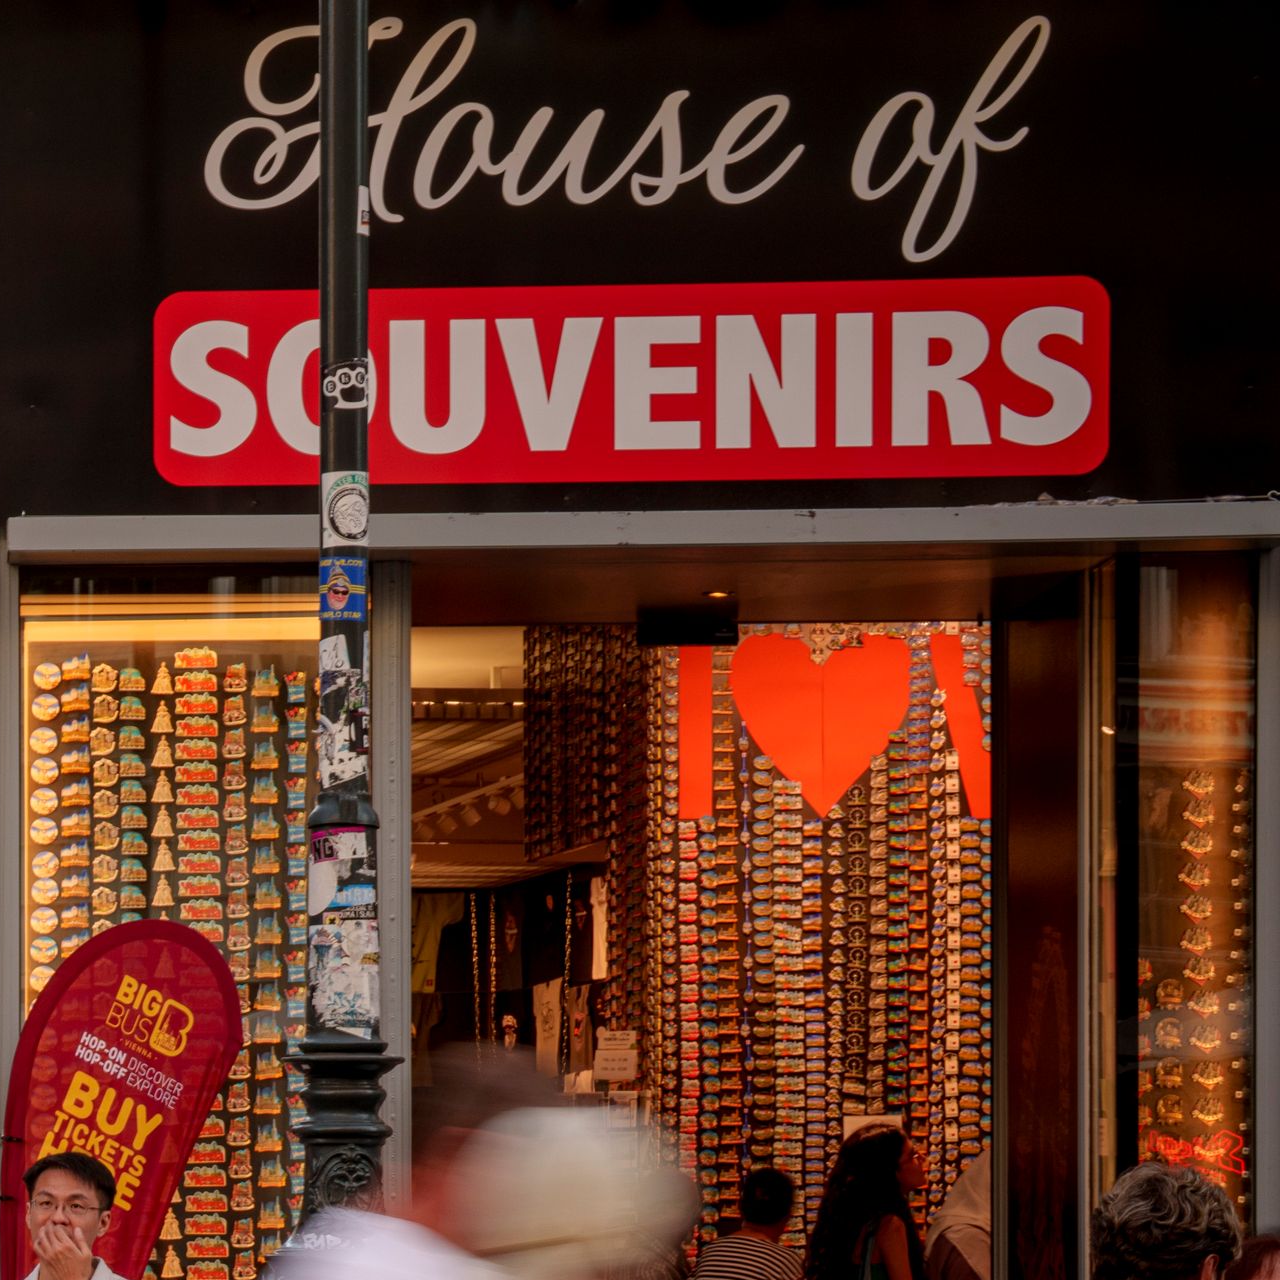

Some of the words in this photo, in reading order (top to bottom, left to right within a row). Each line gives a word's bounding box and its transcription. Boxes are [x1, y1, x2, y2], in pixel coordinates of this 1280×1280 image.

[204, 15, 805, 223] House
[851, 15, 1052, 263] of
[170, 306, 1092, 456] SOUVENIRS
[105, 1001, 153, 1042] BUS
[115, 974, 164, 1017] BIG
[74, 1044, 128, 1080] HOP-OFF
[126, 1073, 180, 1110] EXPLORE
[80, 1031, 127, 1064] HOP-ON
[128, 1056, 184, 1096] DISCOVER
[124, 1040, 152, 1060] VIENNA
[61, 1070, 164, 1150] BUY
[37, 1131, 141, 1212] HE
[54, 1110, 147, 1178] TICKETS
